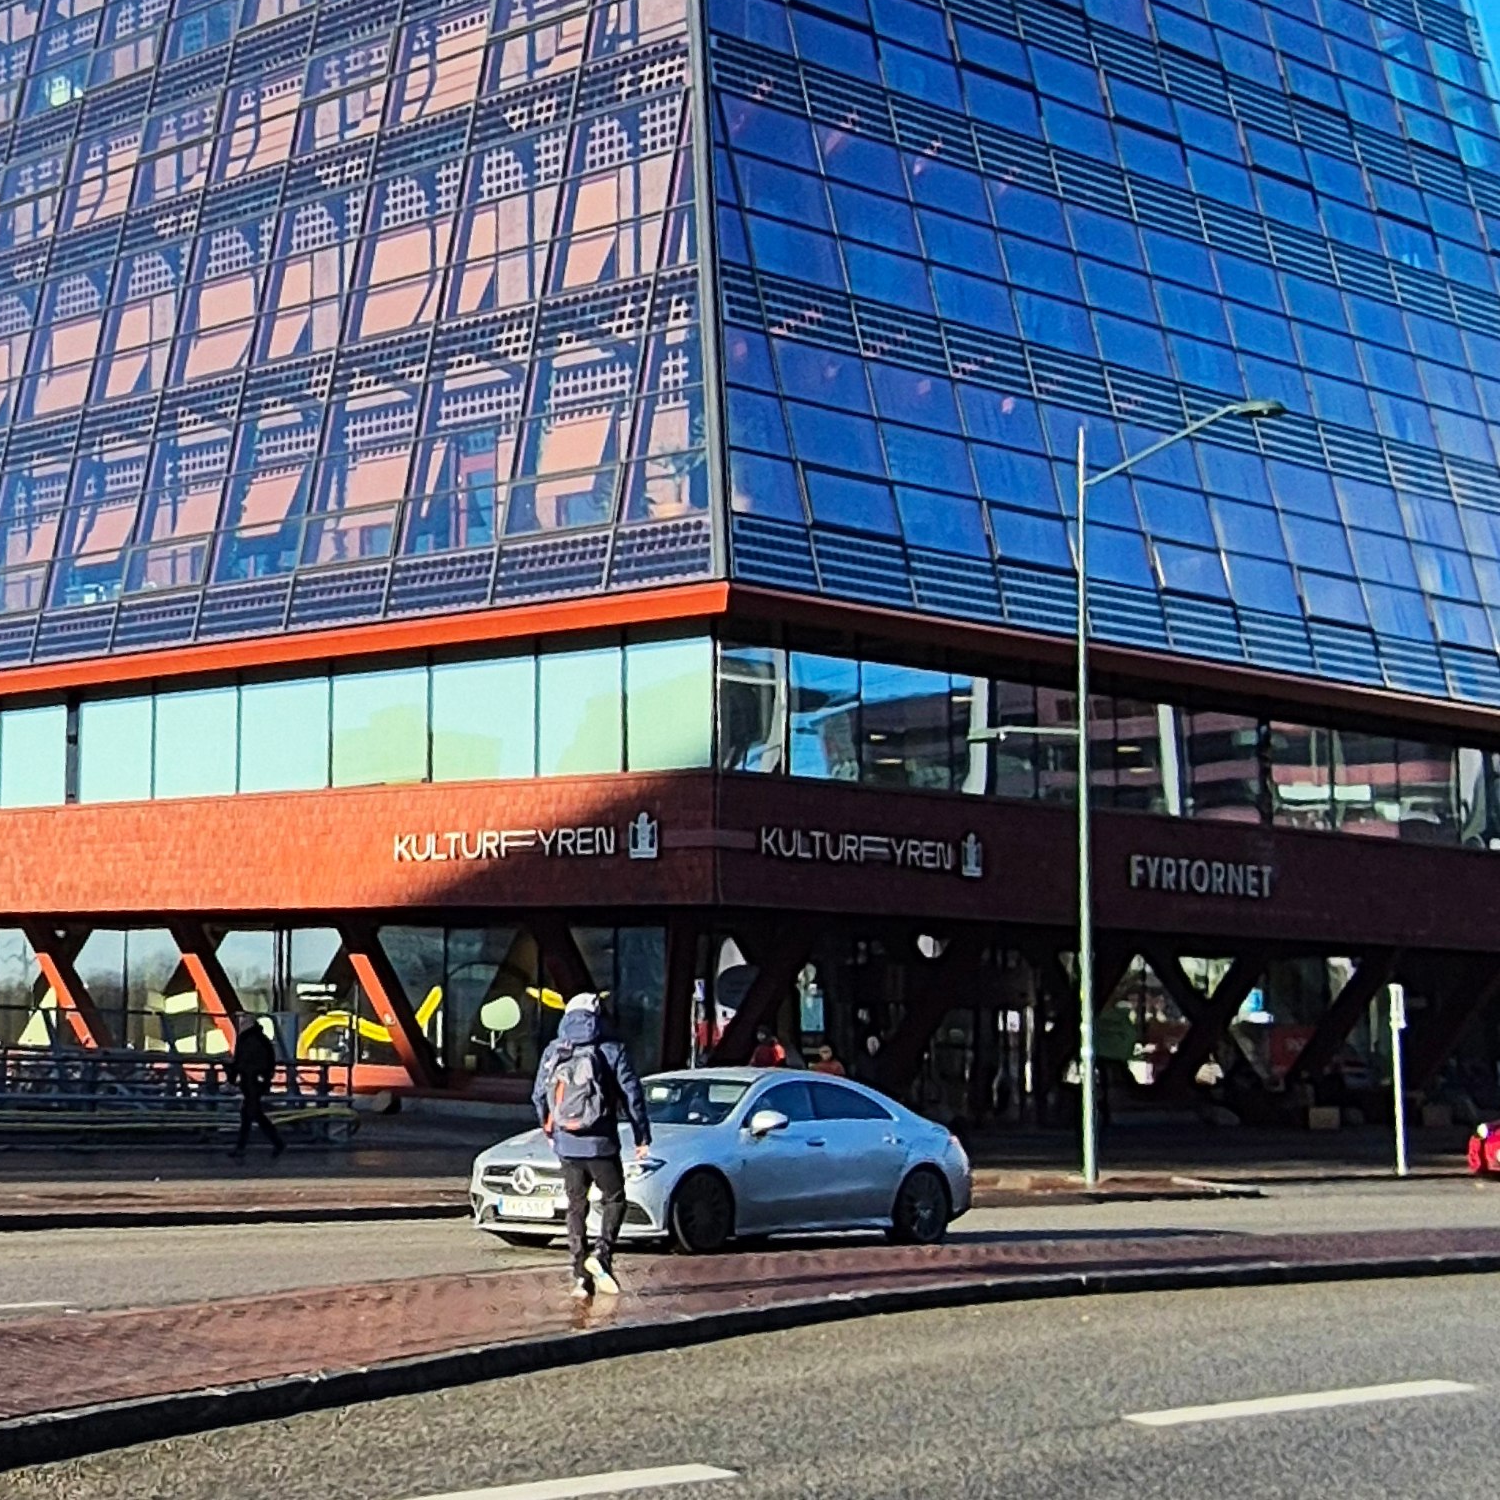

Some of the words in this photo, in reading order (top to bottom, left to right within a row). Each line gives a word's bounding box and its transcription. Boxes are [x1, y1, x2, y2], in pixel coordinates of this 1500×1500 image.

[393, 827, 615, 861] KULTURFYREN
[761, 826, 952, 870] KULTURFYREN
[1130, 854, 1272, 897] FYRTORNET
